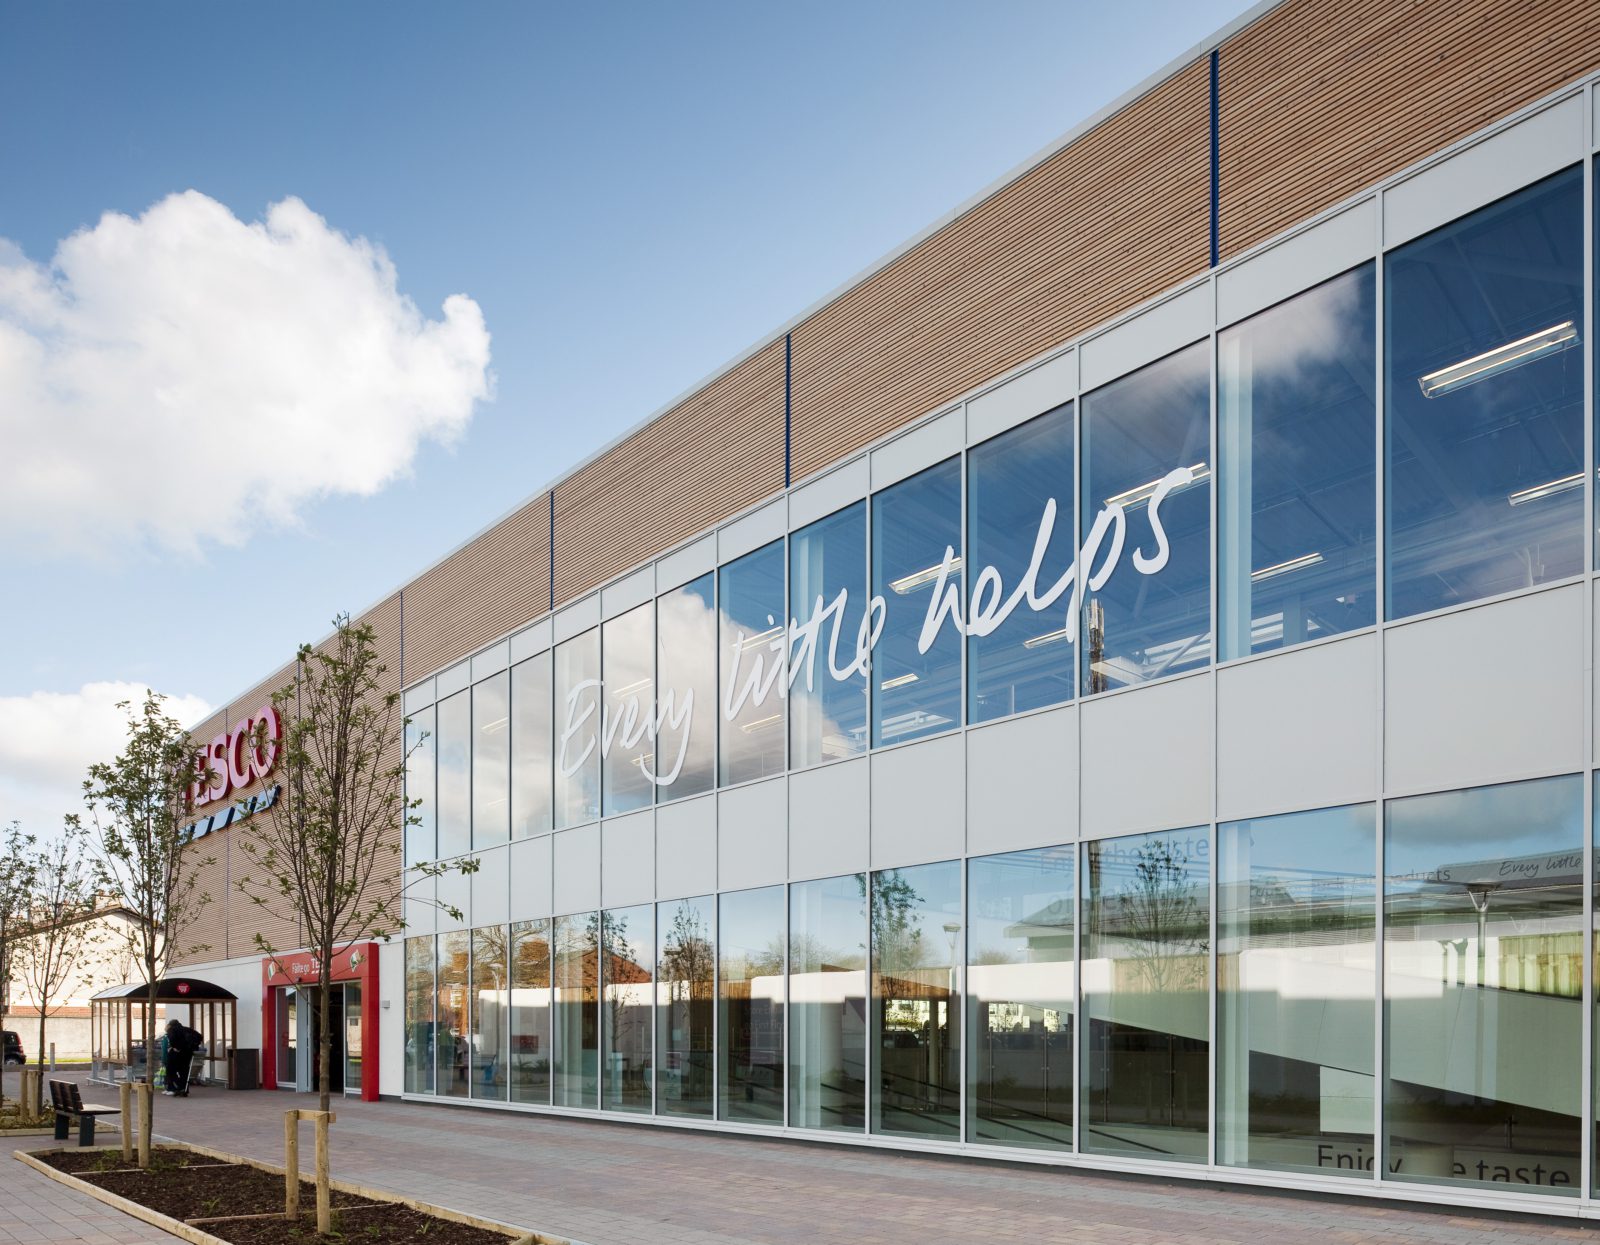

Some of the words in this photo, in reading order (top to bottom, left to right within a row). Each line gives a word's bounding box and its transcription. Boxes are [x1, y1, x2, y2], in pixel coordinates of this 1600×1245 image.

[560, 679, 694, 786] Every
[918, 467, 1194, 655] helps
[171, 705, 282, 812] ESCO
